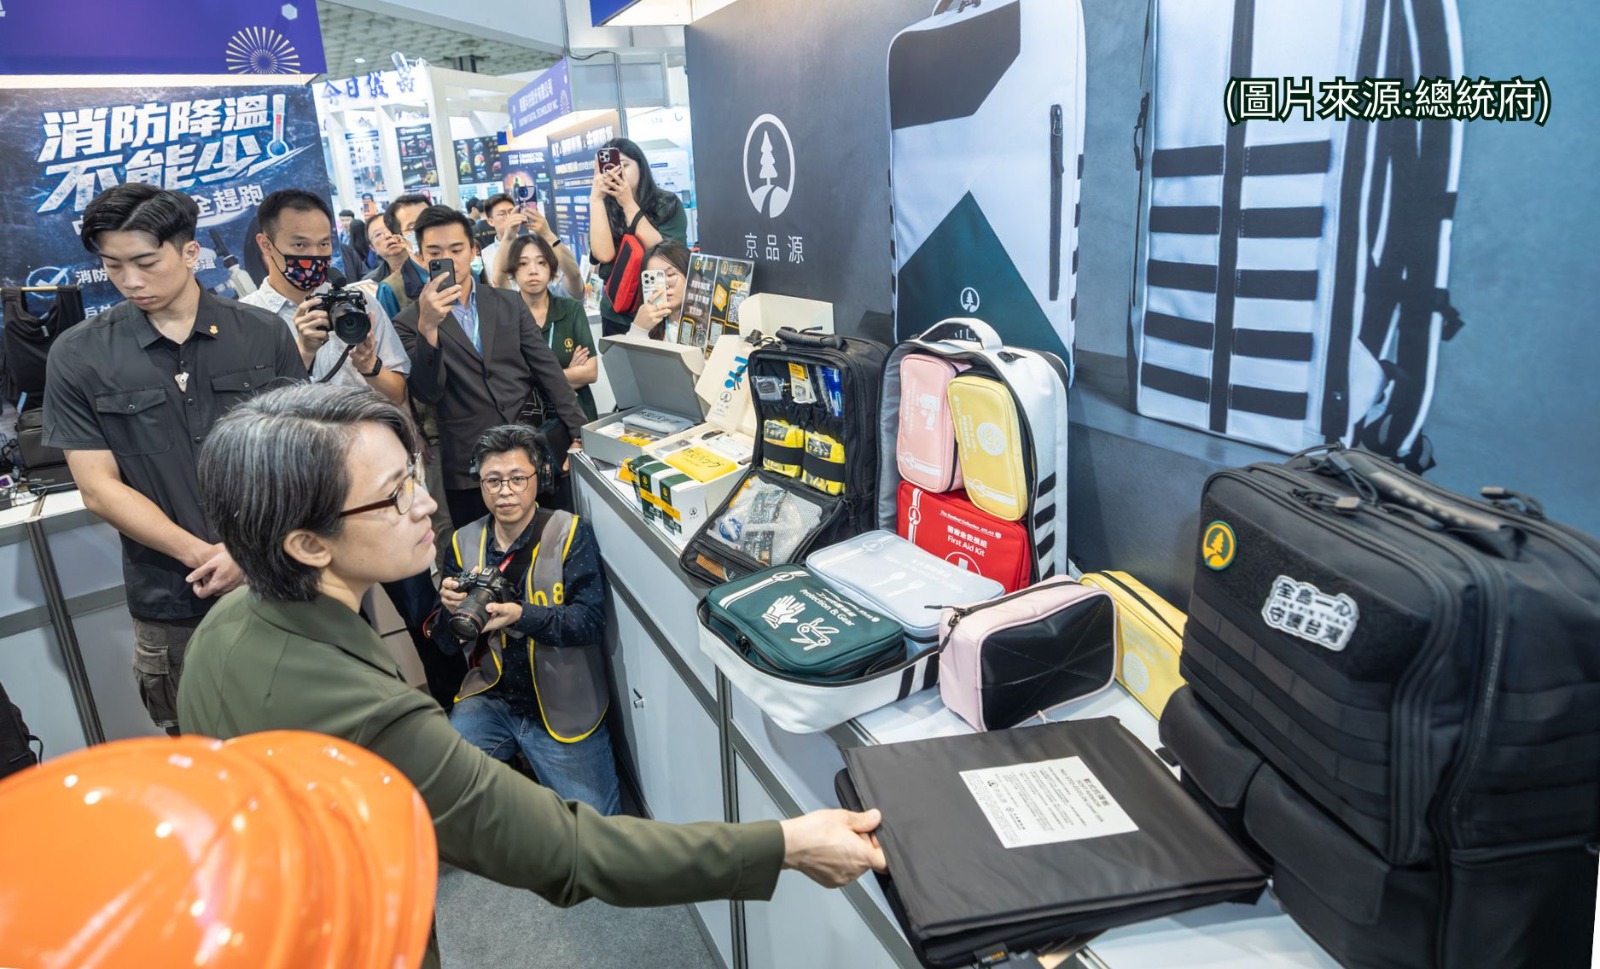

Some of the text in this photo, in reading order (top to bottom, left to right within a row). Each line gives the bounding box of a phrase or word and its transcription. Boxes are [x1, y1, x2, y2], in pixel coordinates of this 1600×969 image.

[37, 94, 271, 163] 消防降溫
[37, 134, 290, 213] 不能少
[744, 232, 804, 264] 京品源
[947, 534, 985, 557] First Aid Kit
